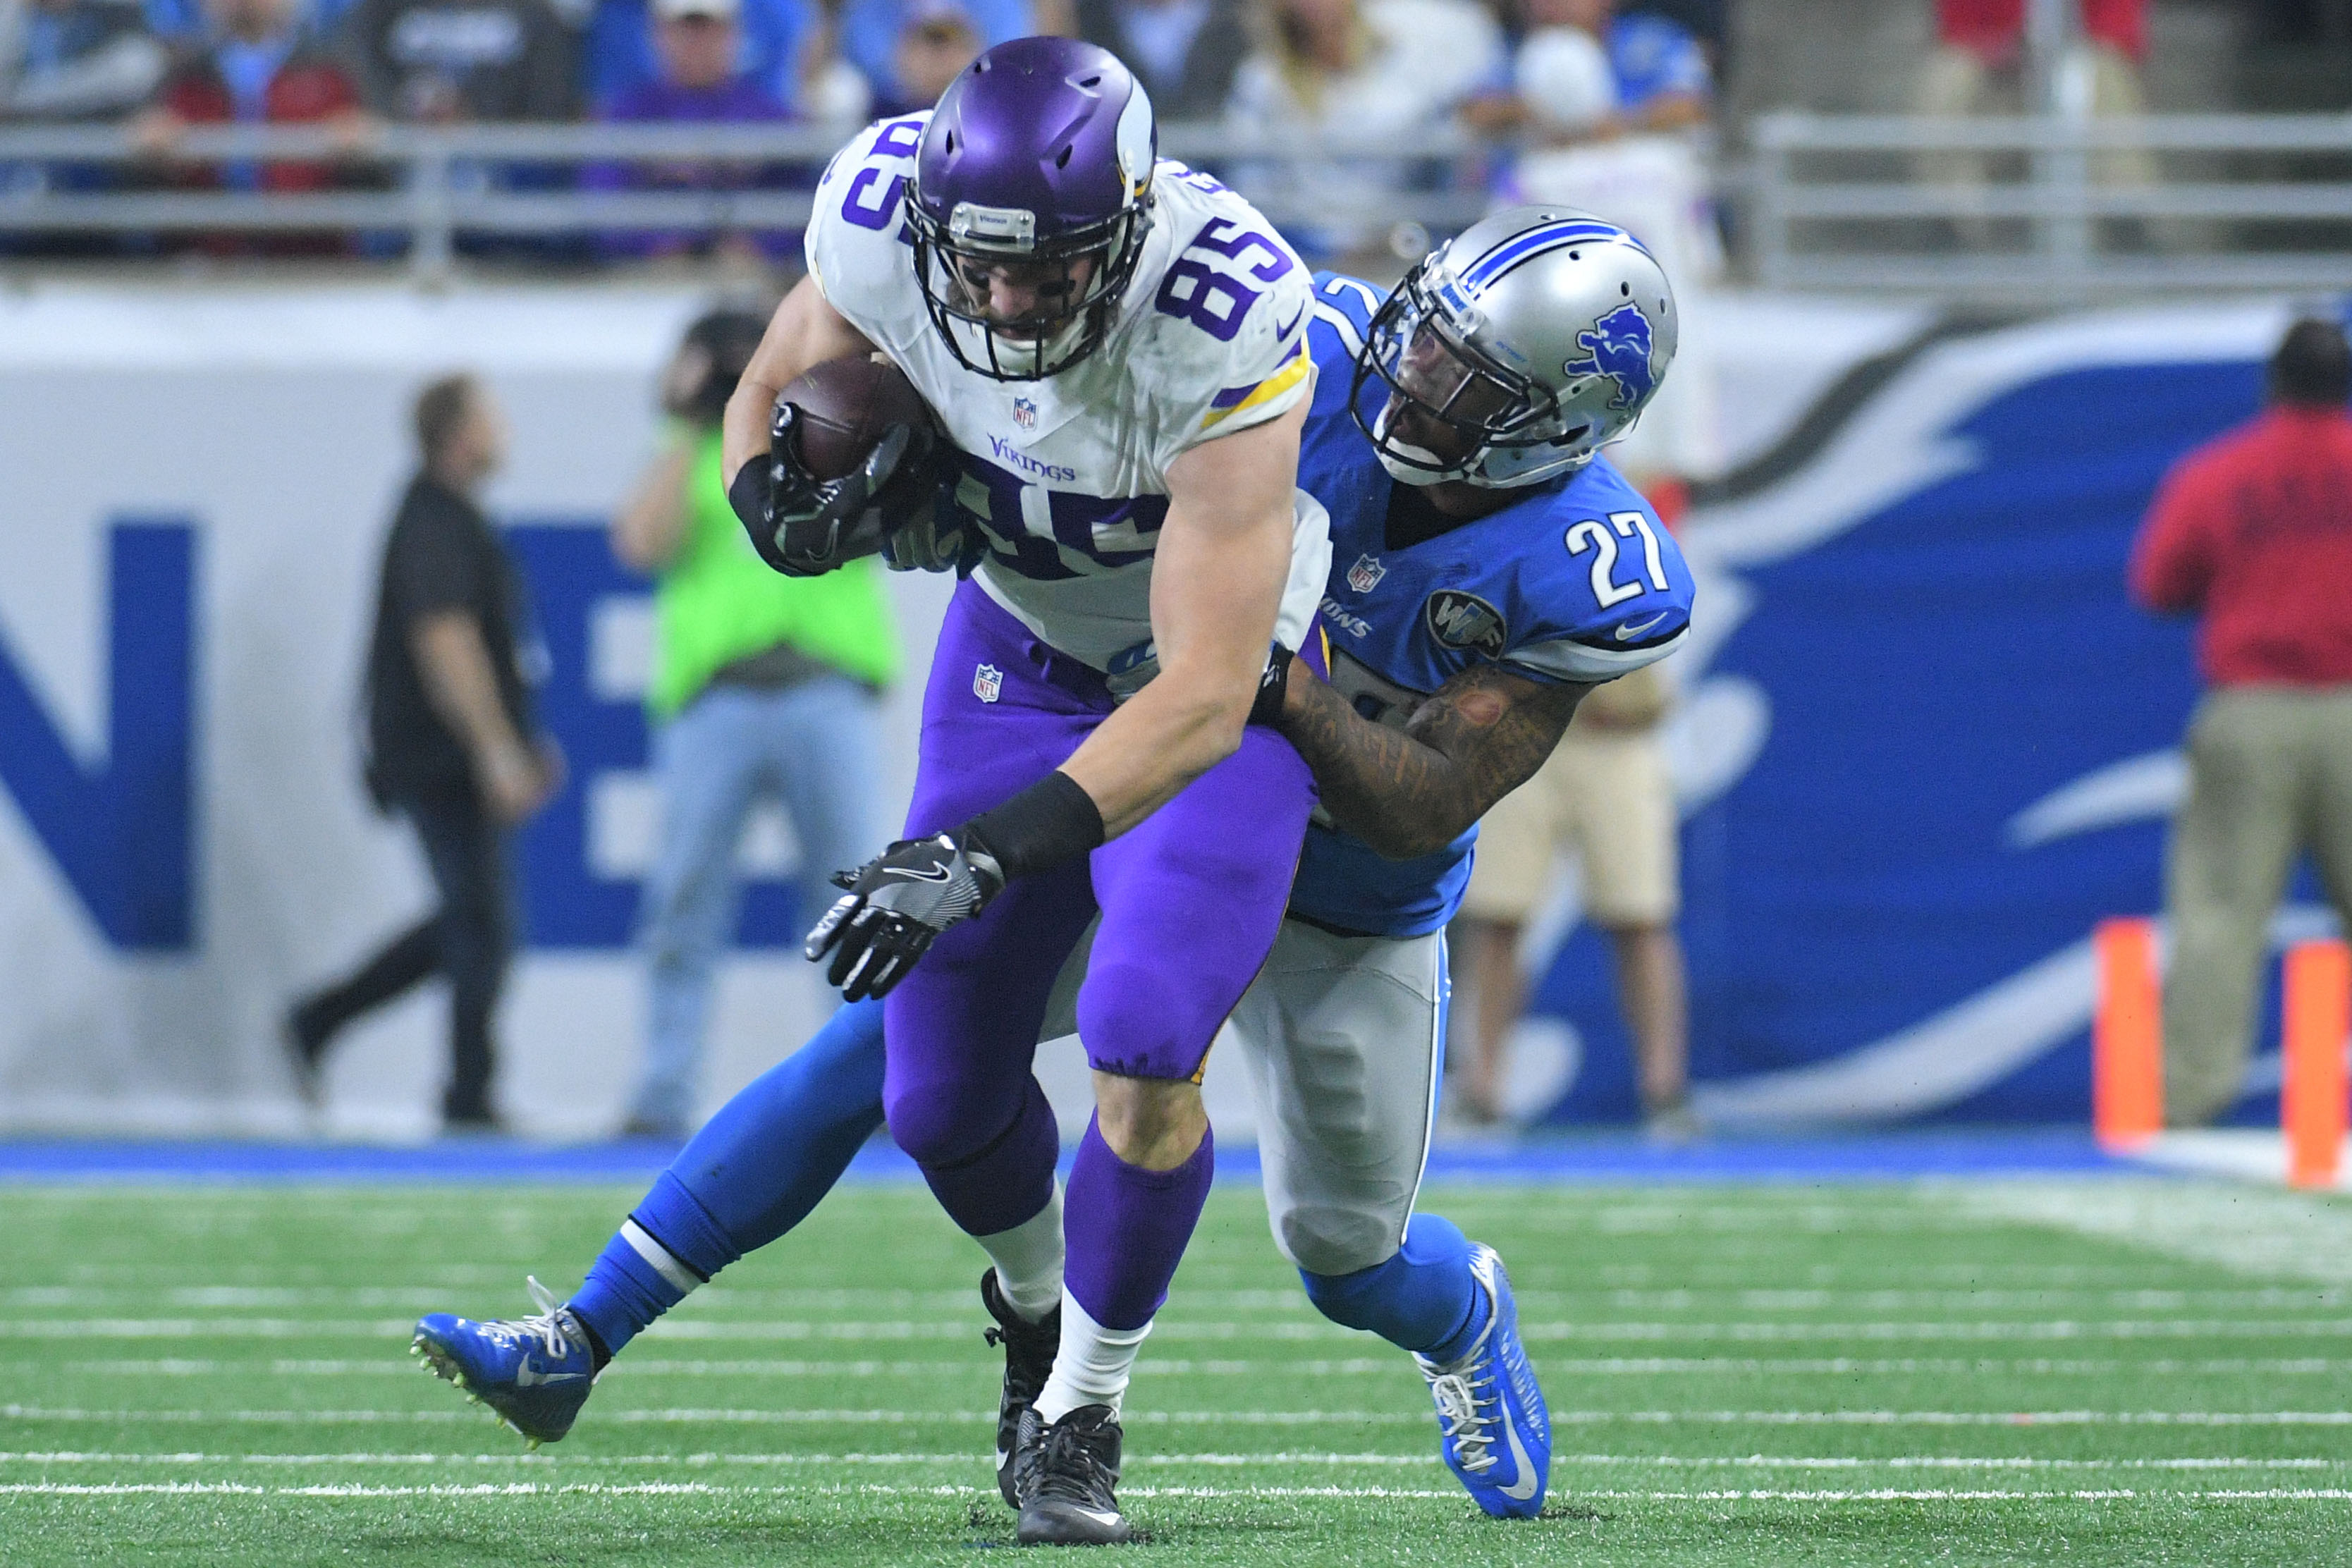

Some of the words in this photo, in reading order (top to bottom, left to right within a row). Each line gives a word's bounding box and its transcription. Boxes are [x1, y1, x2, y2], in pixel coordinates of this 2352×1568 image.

[1154, 216, 1294, 342] 85
[1562, 510, 1670, 609] 27
[1318, 596, 1373, 639] IONS
